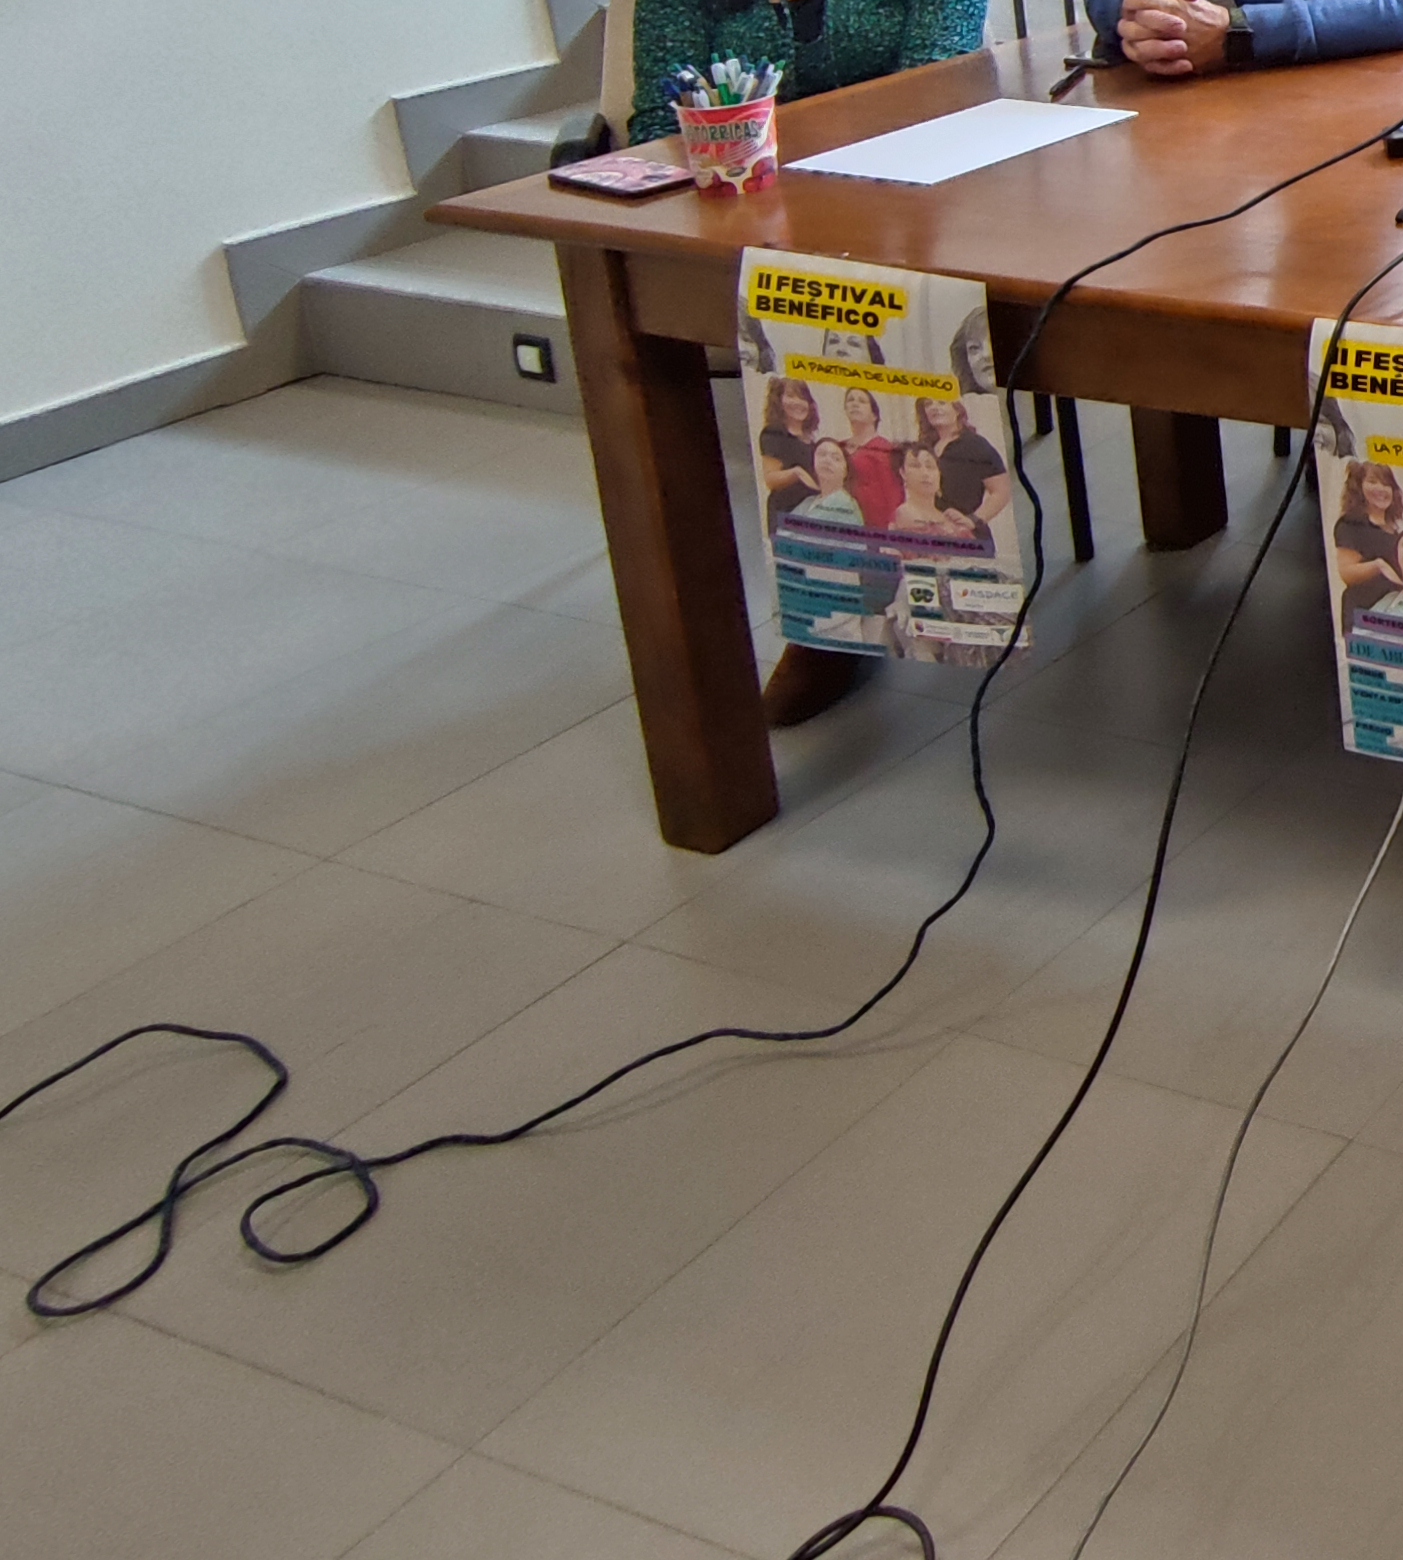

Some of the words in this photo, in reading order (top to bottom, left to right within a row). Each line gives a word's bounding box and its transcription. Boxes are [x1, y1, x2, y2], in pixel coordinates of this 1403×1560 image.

[757, 272, 772, 290] II
[776, 276, 903, 311] FESTIVAL
[756, 295, 880, 328] BENÉFICO
[791, 360, 807, 370] LA
[808, 361, 861, 379] PARTIDA
[863, 370, 885, 382] DE
[887, 374, 909, 386] LAS
[912, 377, 953, 391] CINCO
[1374, 442, 1390, 454] LA
